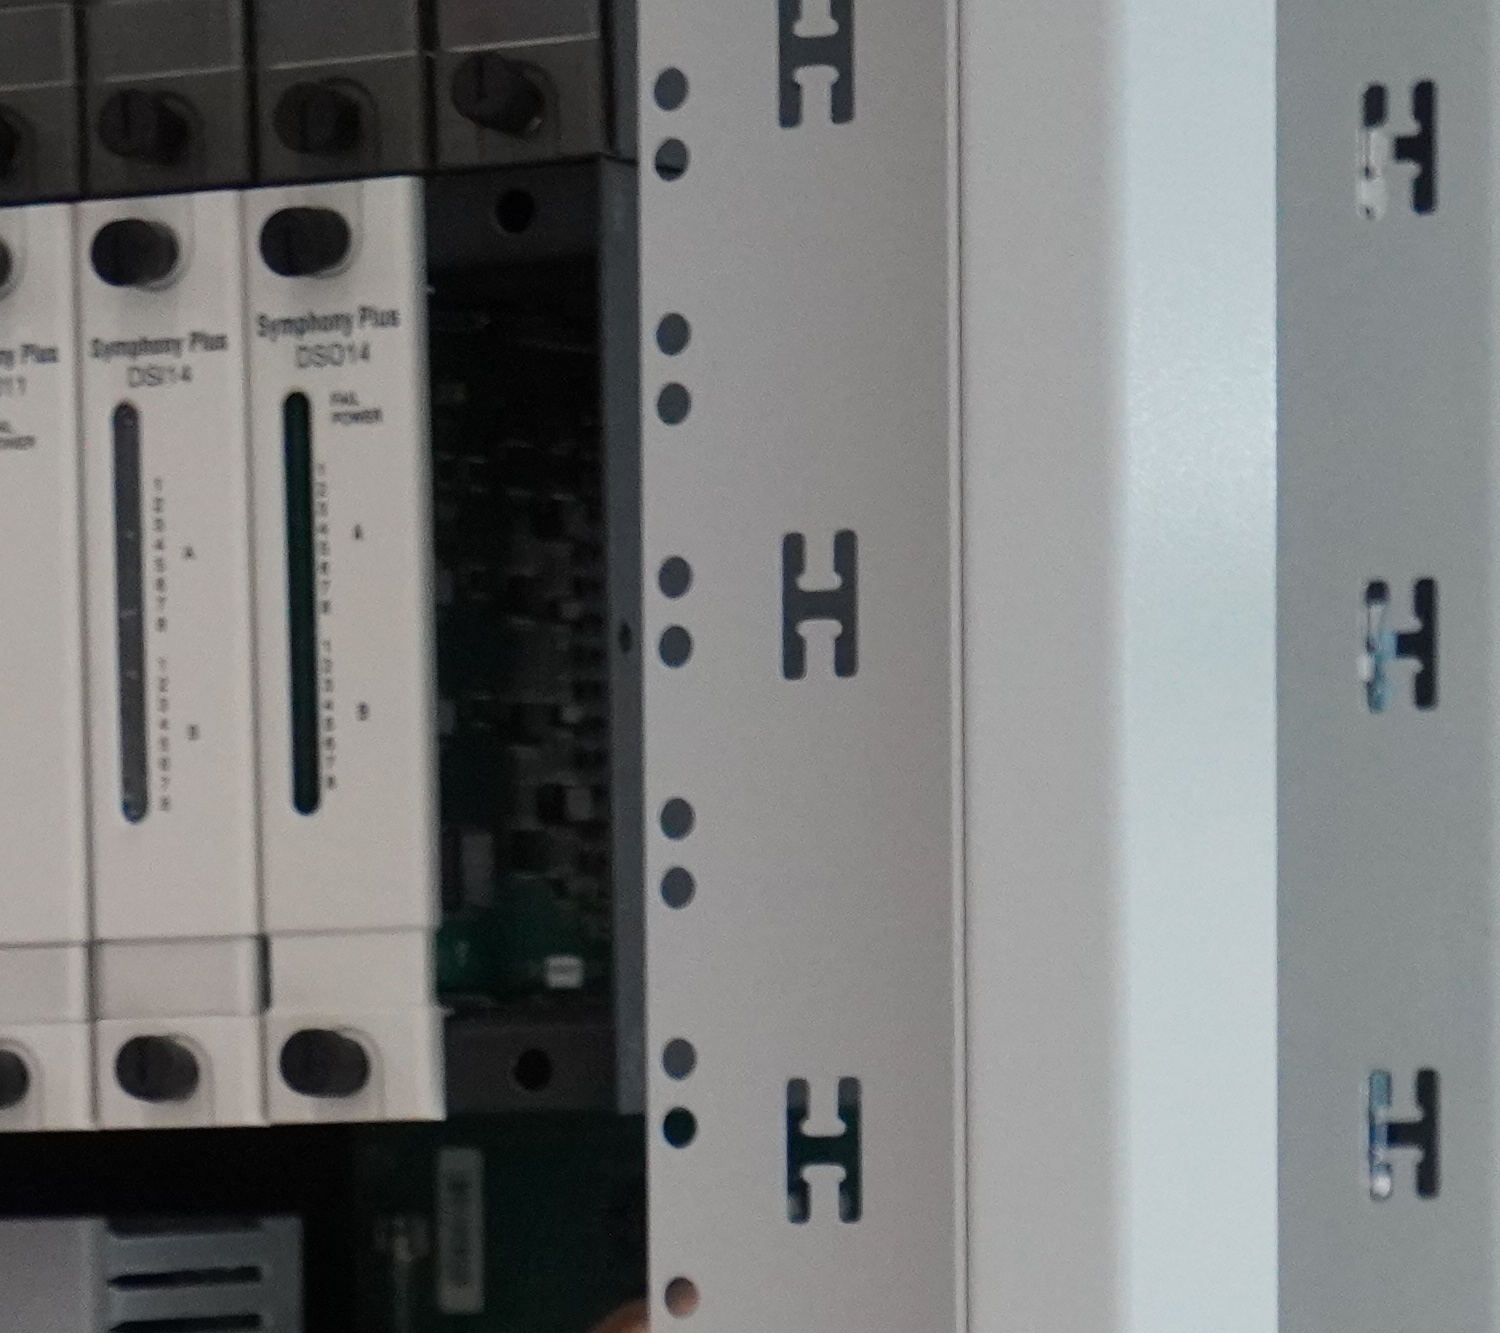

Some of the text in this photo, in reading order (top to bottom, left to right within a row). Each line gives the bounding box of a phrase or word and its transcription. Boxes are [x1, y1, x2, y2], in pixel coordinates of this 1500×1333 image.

[257, 305, 399, 337] Symphony Plus
[91, 331, 228, 359] Symphony Plus
[296, 342, 370, 370] DSO14
